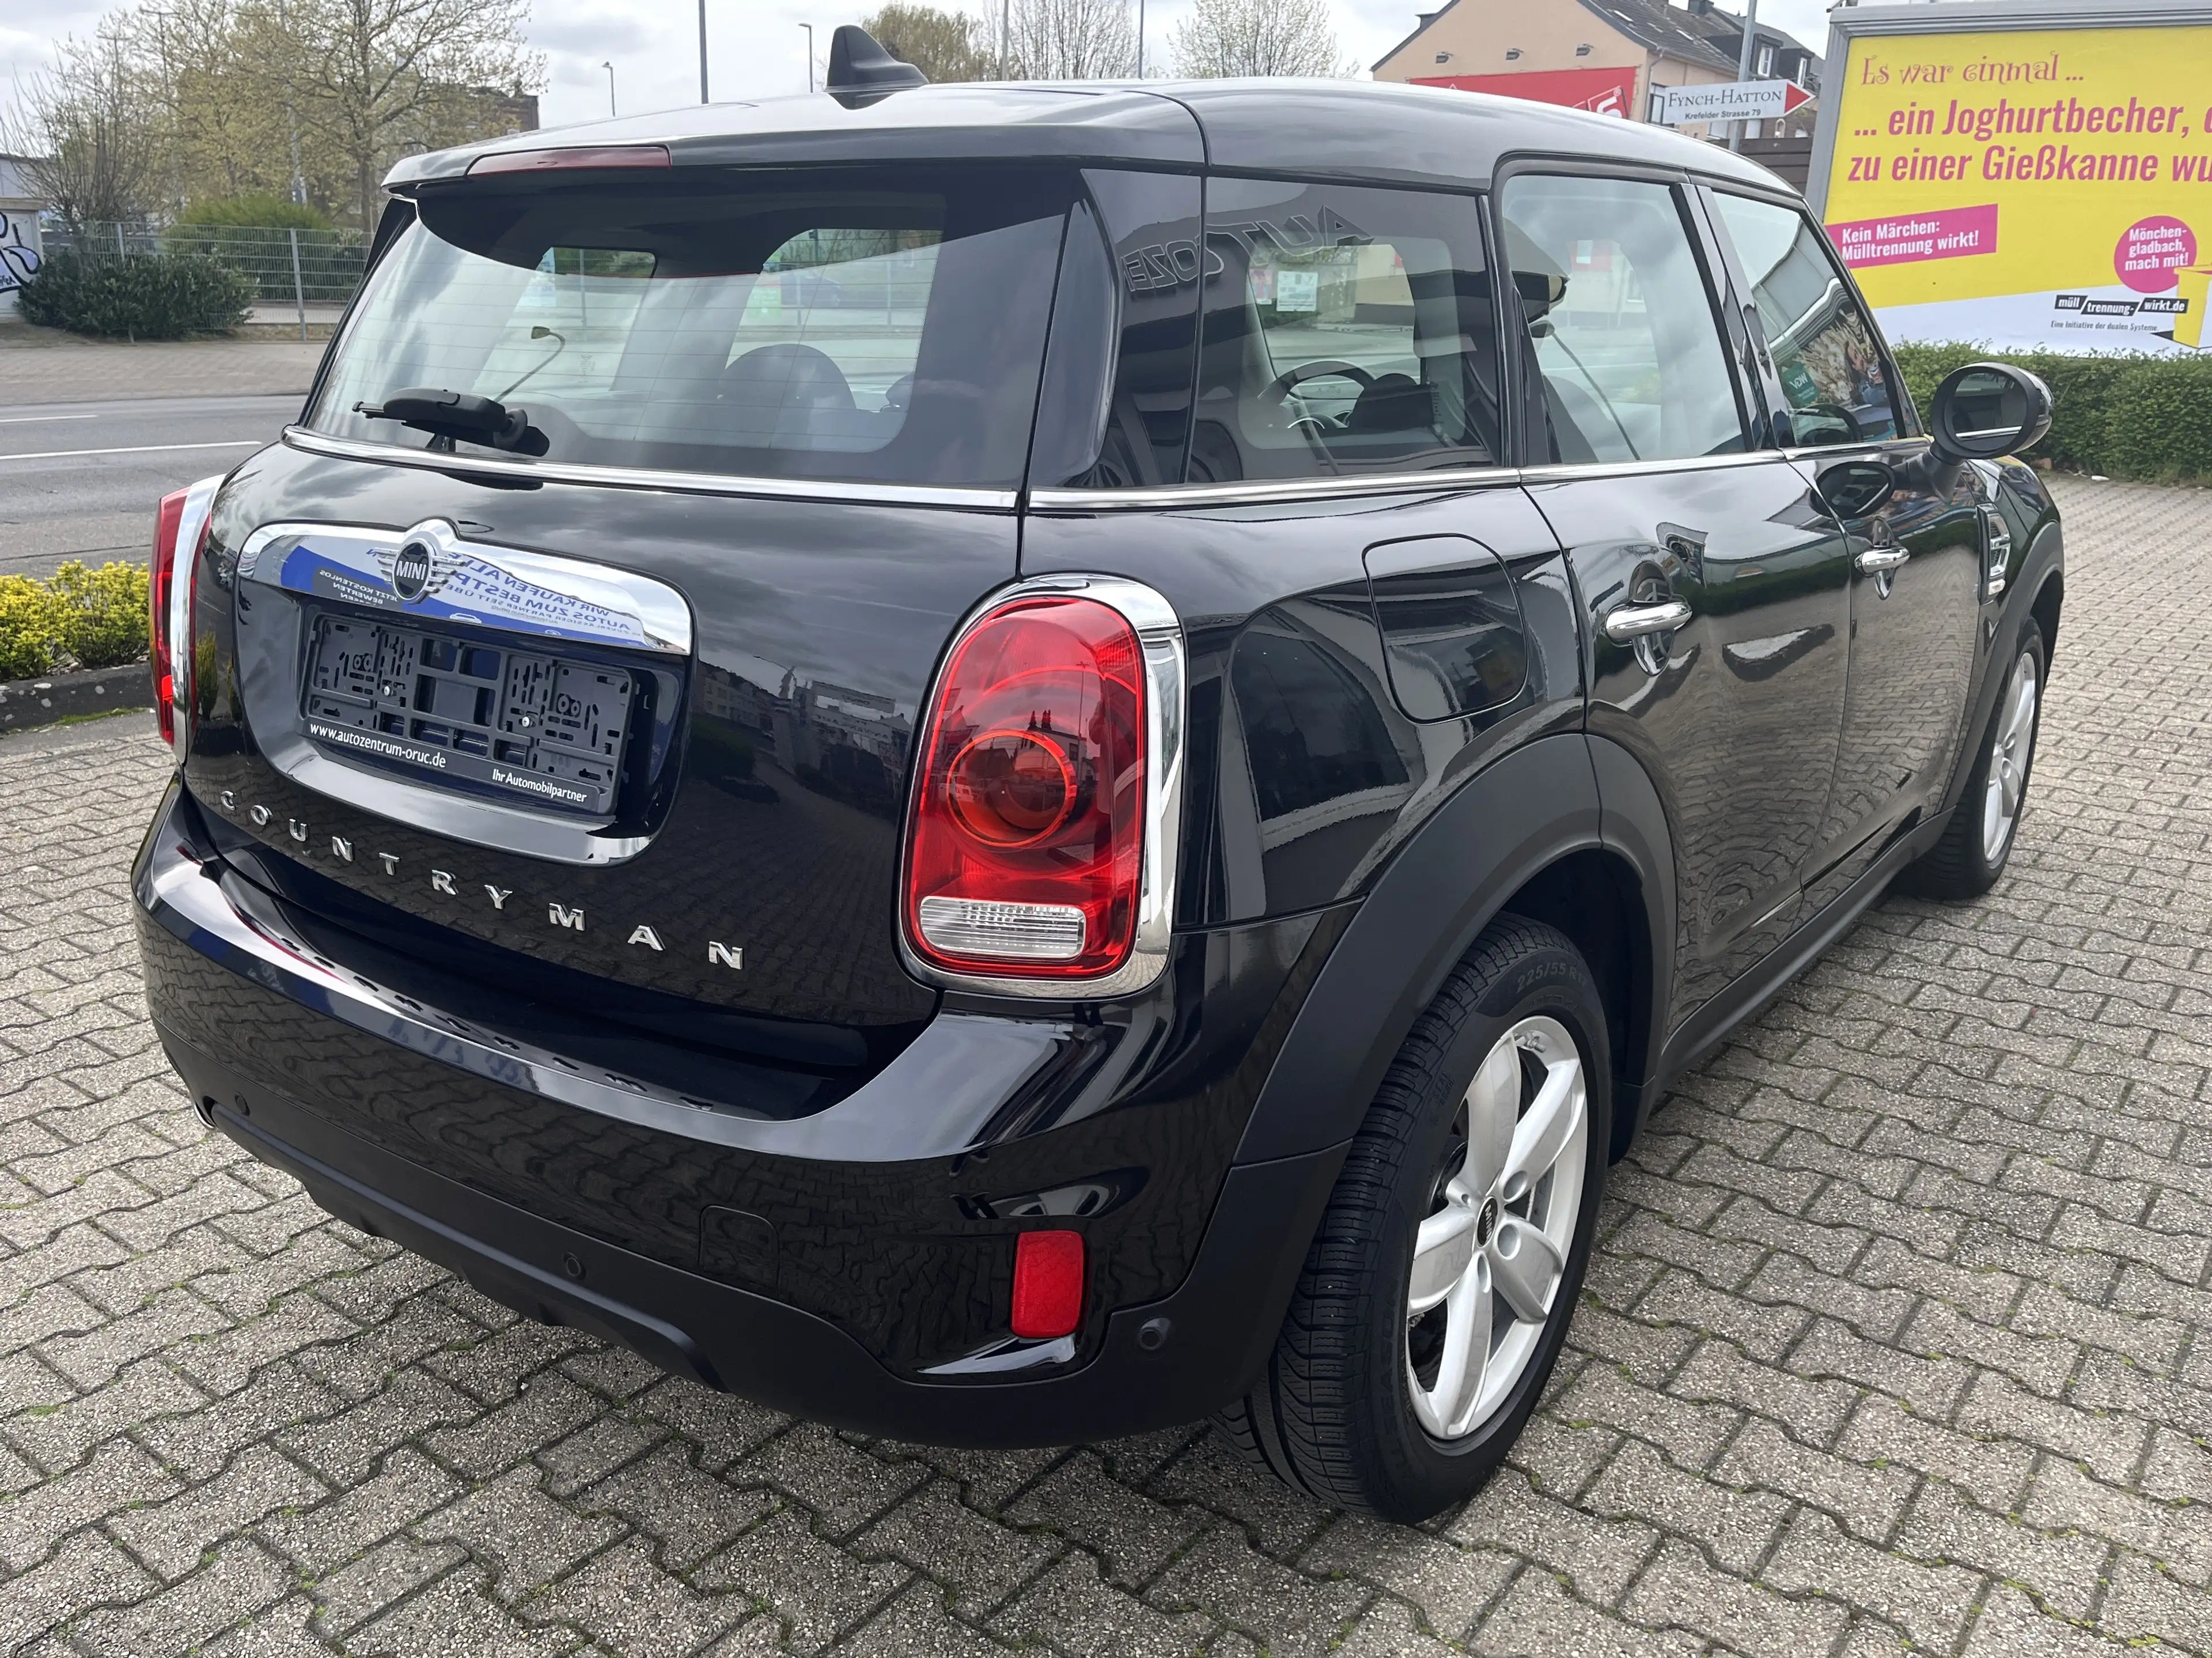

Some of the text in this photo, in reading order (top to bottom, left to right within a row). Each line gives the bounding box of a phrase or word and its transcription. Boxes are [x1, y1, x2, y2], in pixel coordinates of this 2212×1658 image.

[1861, 55, 1890, 85] Es
[1899, 64, 1954, 85] war
[1963, 50, 2059, 85] einmal
[1685, 111, 1718, 120] Krefelder
[1721, 109, 1749, 118] Strasse
[1888, 101, 1934, 135] ein
[1942, 97, 2189, 141] Joghurtbecher,
[1848, 156, 1881, 181] zu
[1891, 147, 1972, 181] einer
[1983, 145, 2158, 181] Gießkanne
[1842, 219, 1940, 244] Kein Märchen:
[1842, 230, 1979, 261] Mülltrennung wirkt!
[2129, 226, 2187, 242] Mönchen-
[2125, 252, 2190, 271] mach mit!
[2128, 239, 2186, 258] gladbach,
[2058, 296, 2080, 308] müll
[2144, 300, 2185, 312] wirkt.de
[2065, 320, 2093, 329] Initiative
[396, 561, 426, 580] MINI
[310, 723, 446, 769] www.autozentrum-oruc.de
[492, 768, 587, 802] Ihr Automobilpartner
[220, 790, 744, 970] COUNTRYMAN
[1516, 962, 1566, 994] 225/55
[1484, 1203, 1493, 1244] MINI
